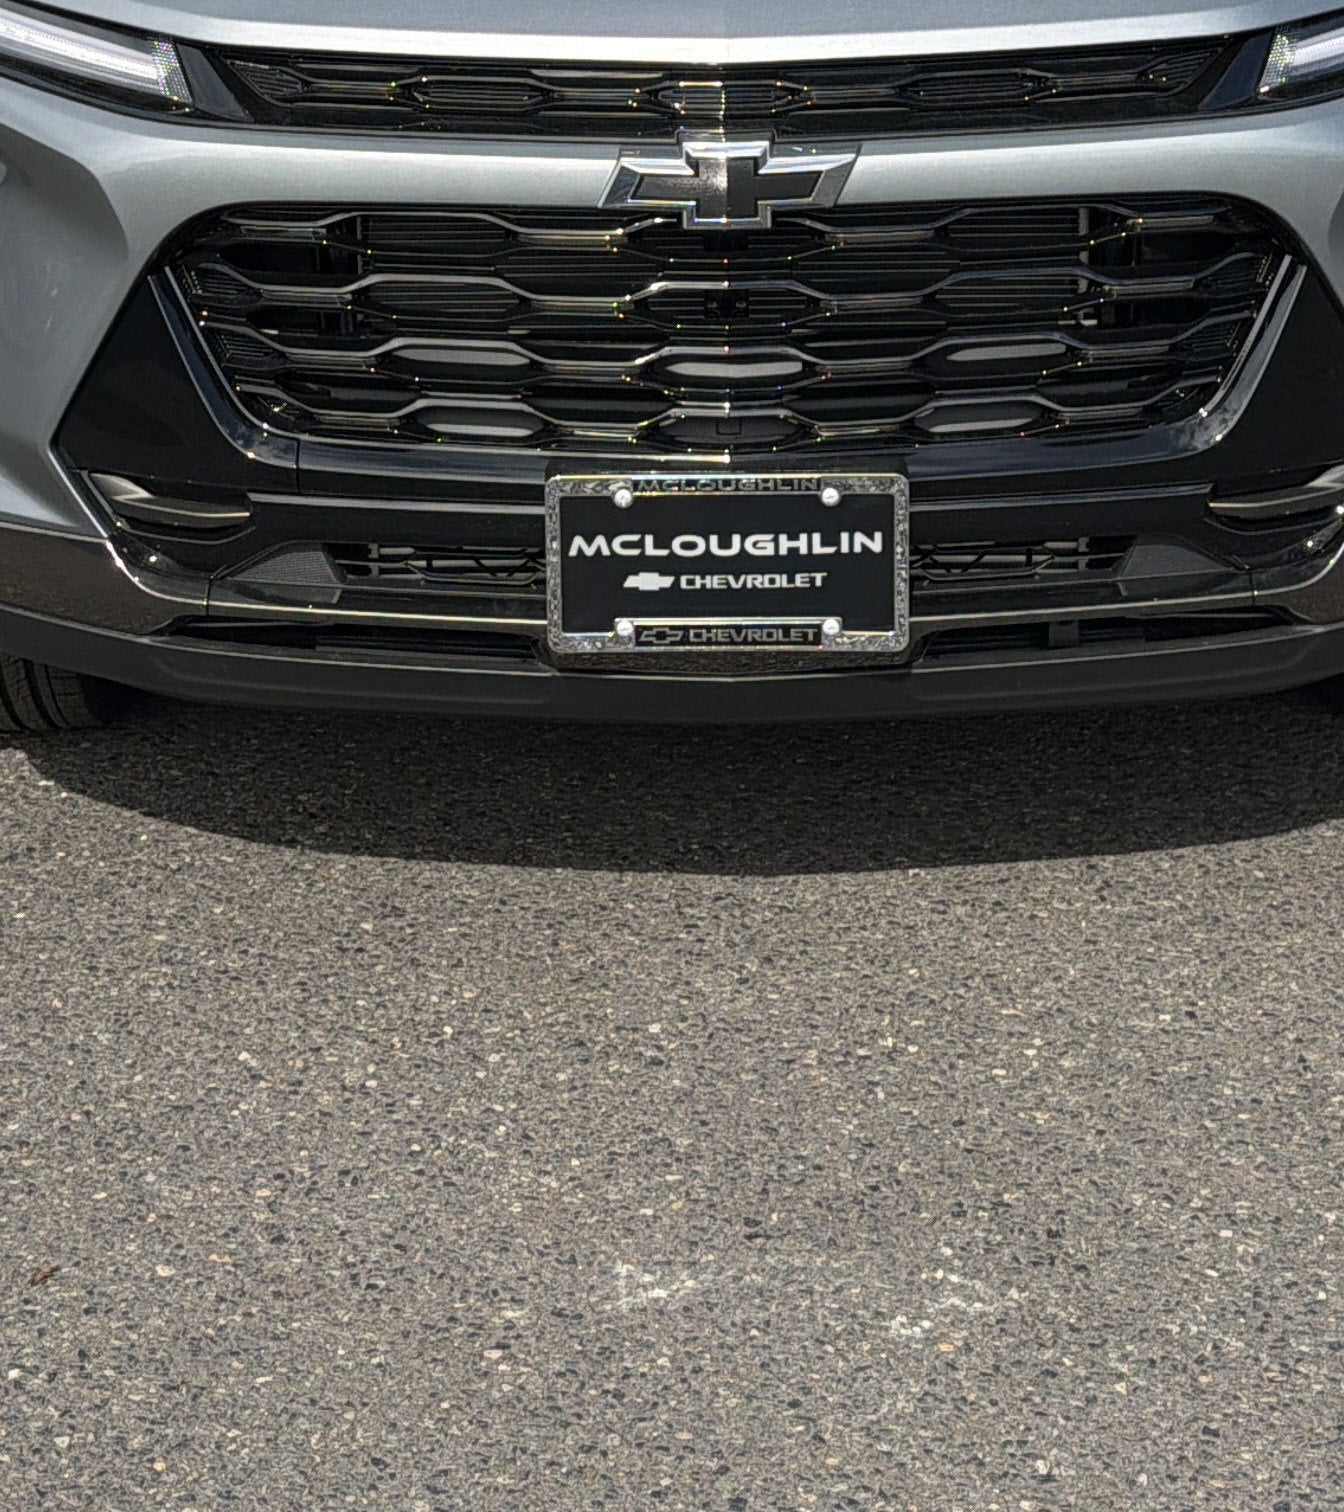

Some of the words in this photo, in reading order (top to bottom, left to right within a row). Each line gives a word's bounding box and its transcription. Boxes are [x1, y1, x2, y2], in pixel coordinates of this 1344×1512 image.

[637, 478, 818, 491] MCLOUGHLIN
[568, 531, 883, 558] MCLOUGHLIN
[679, 572, 828, 590] CHEVROLET
[689, 628, 819, 643] CHEVROLET
